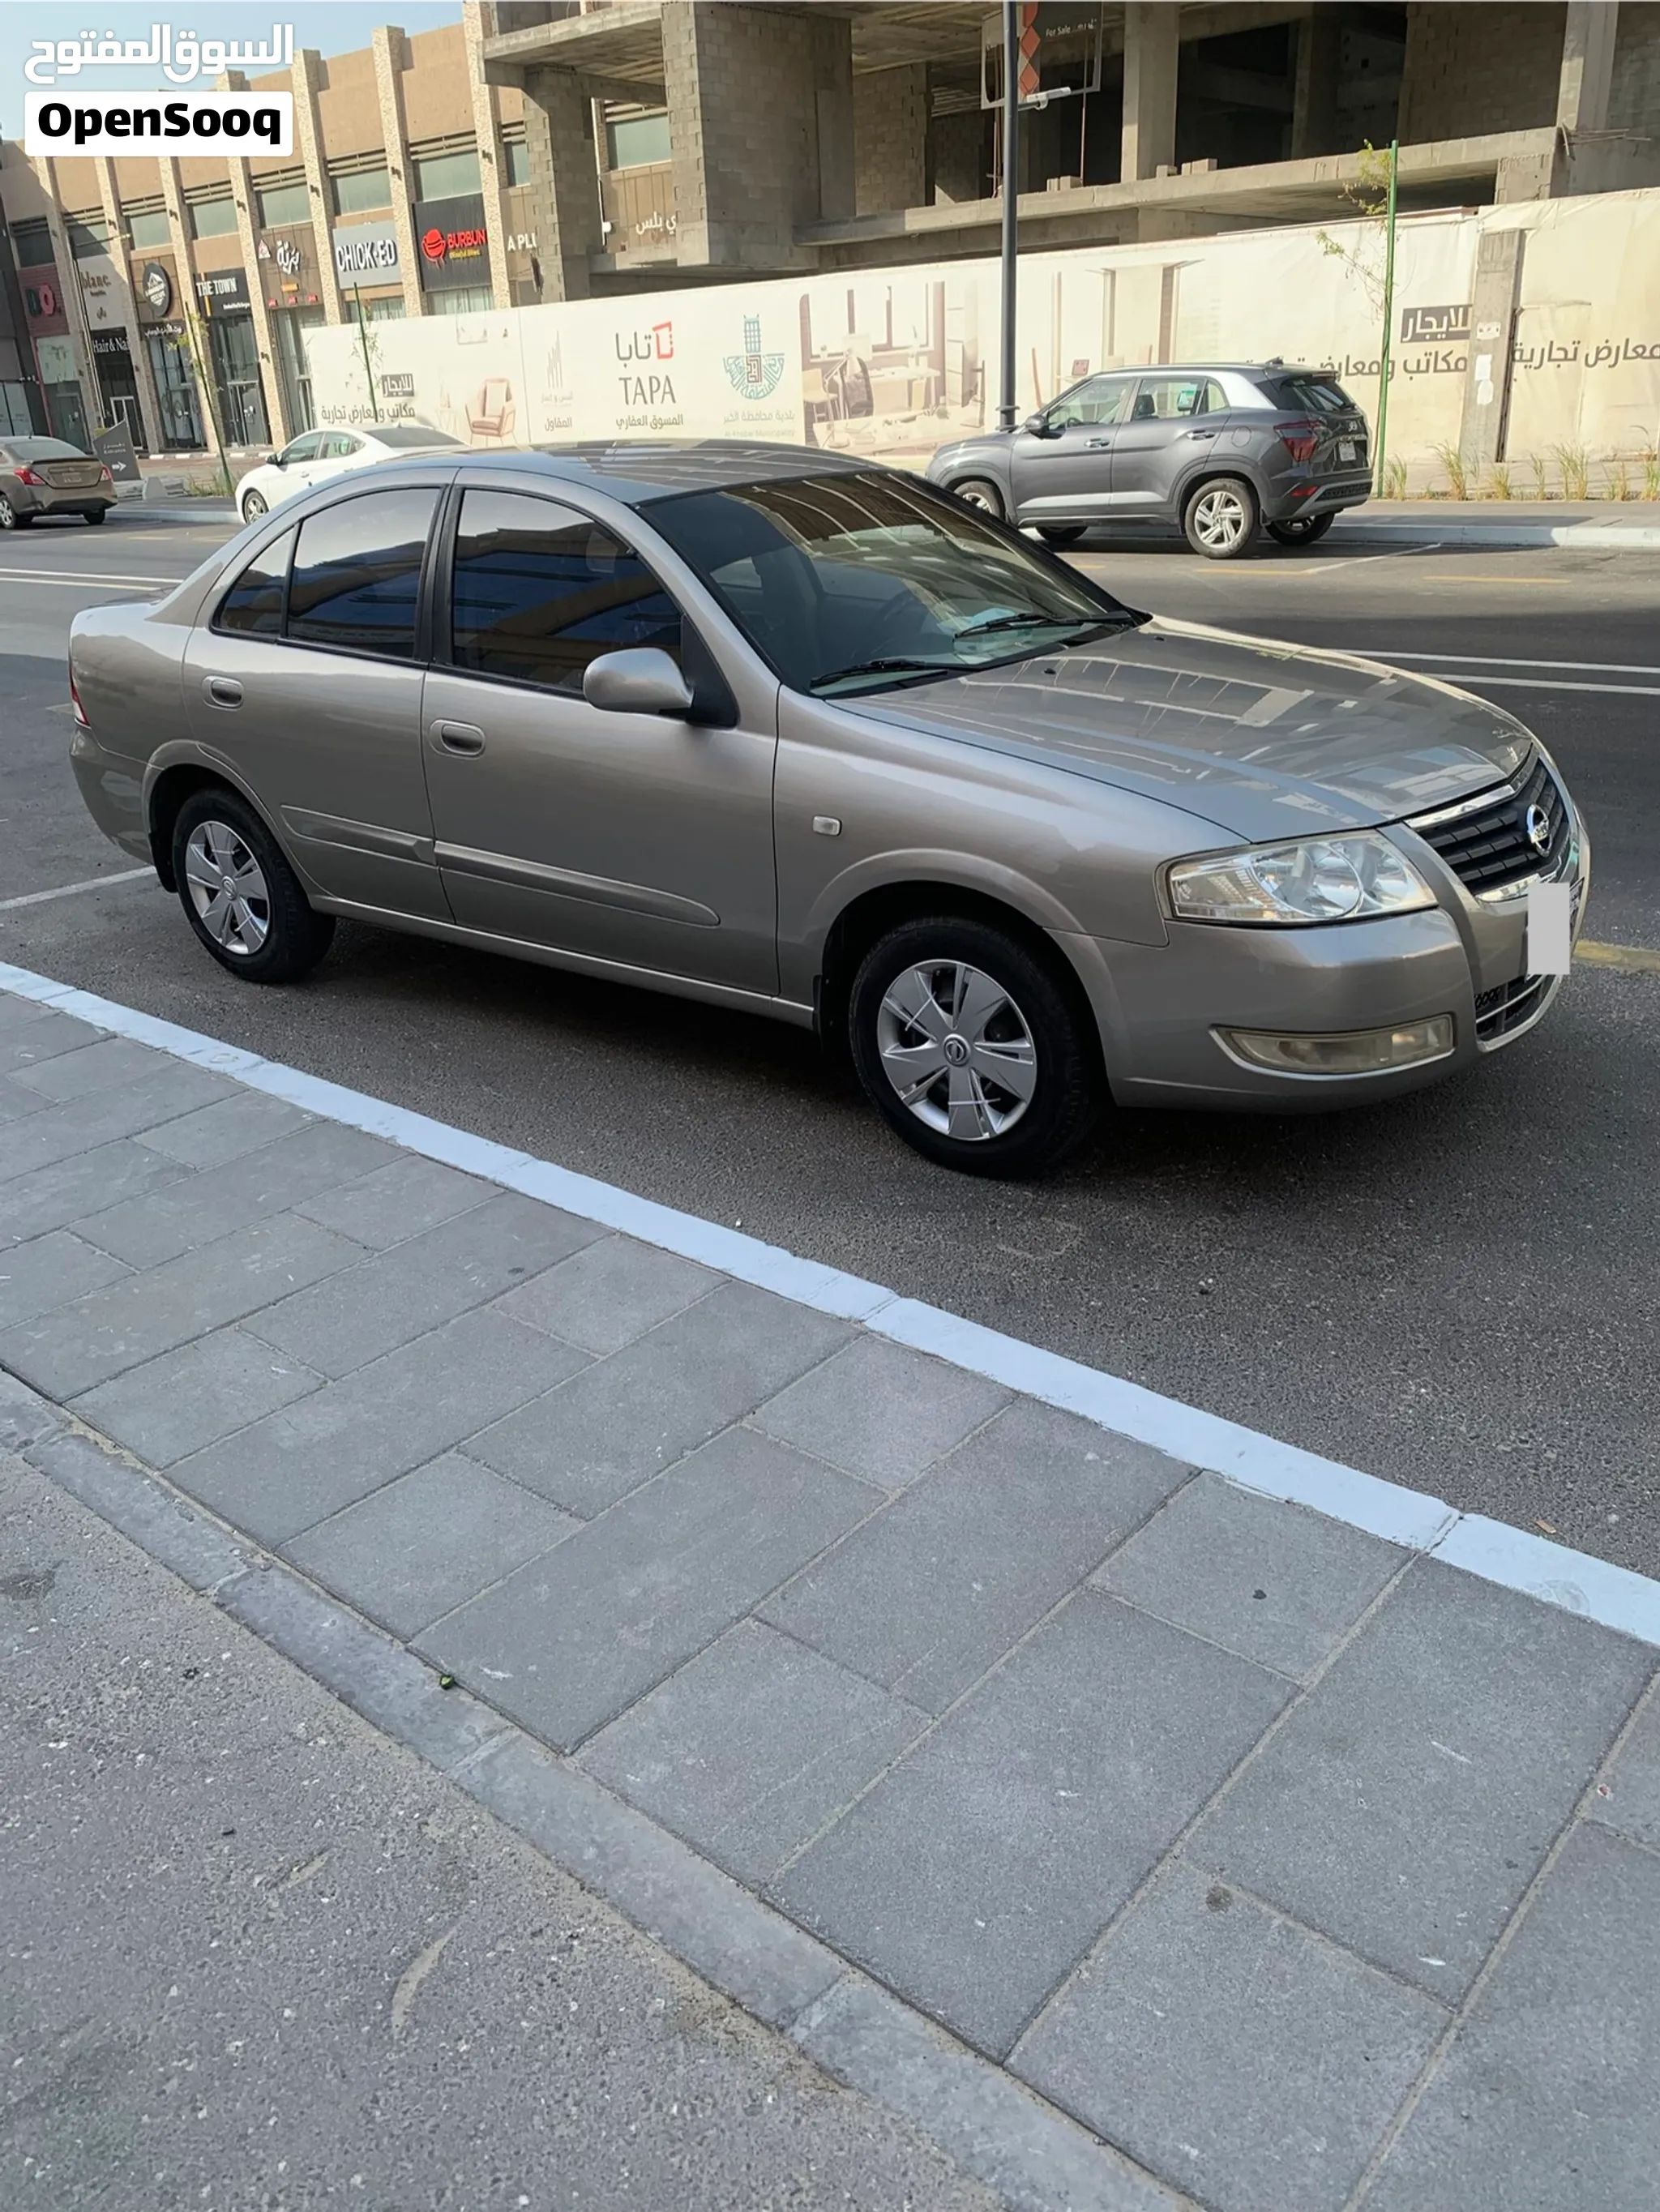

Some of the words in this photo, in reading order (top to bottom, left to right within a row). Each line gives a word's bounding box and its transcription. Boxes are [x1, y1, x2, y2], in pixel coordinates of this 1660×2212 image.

[635, 211, 663, 235] بلس
[447, 228, 486, 249] BURBUN
[507, 234, 516, 251] A
[196, 281, 214, 297] THE
[213, 277, 237, 296] TOWN
[1403, 349, 1468, 381] مكاتب
[1513, 340, 1581, 370] تجارية
[618, 374, 676, 405] TAPA
[321, 405, 347, 424] تجارية
[387, 403, 416, 422] مكاتب
